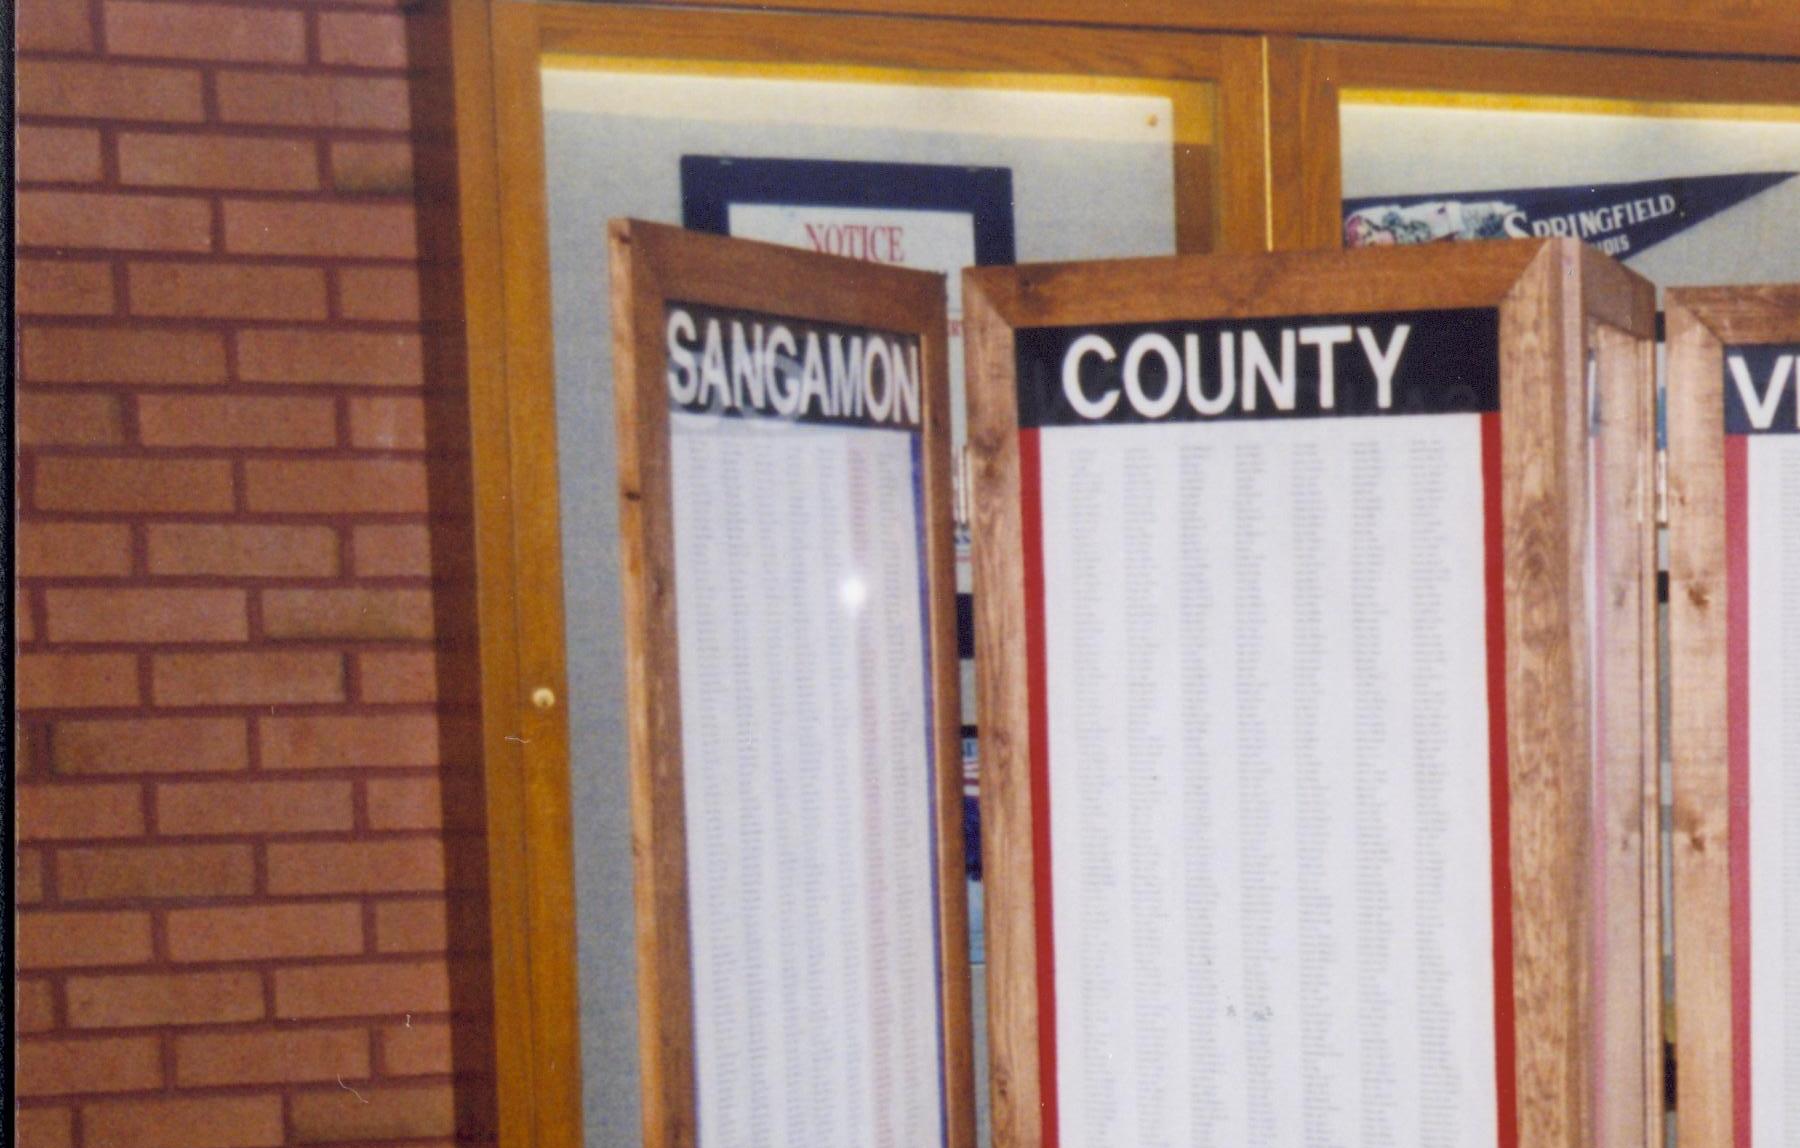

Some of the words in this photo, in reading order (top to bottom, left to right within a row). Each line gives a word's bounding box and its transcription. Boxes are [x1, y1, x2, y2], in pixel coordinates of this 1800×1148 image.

[803, 223, 905, 262] NOTICE
[666, 308, 920, 425] SANGAMON
[1061, 324, 1411, 420] COUNTY
